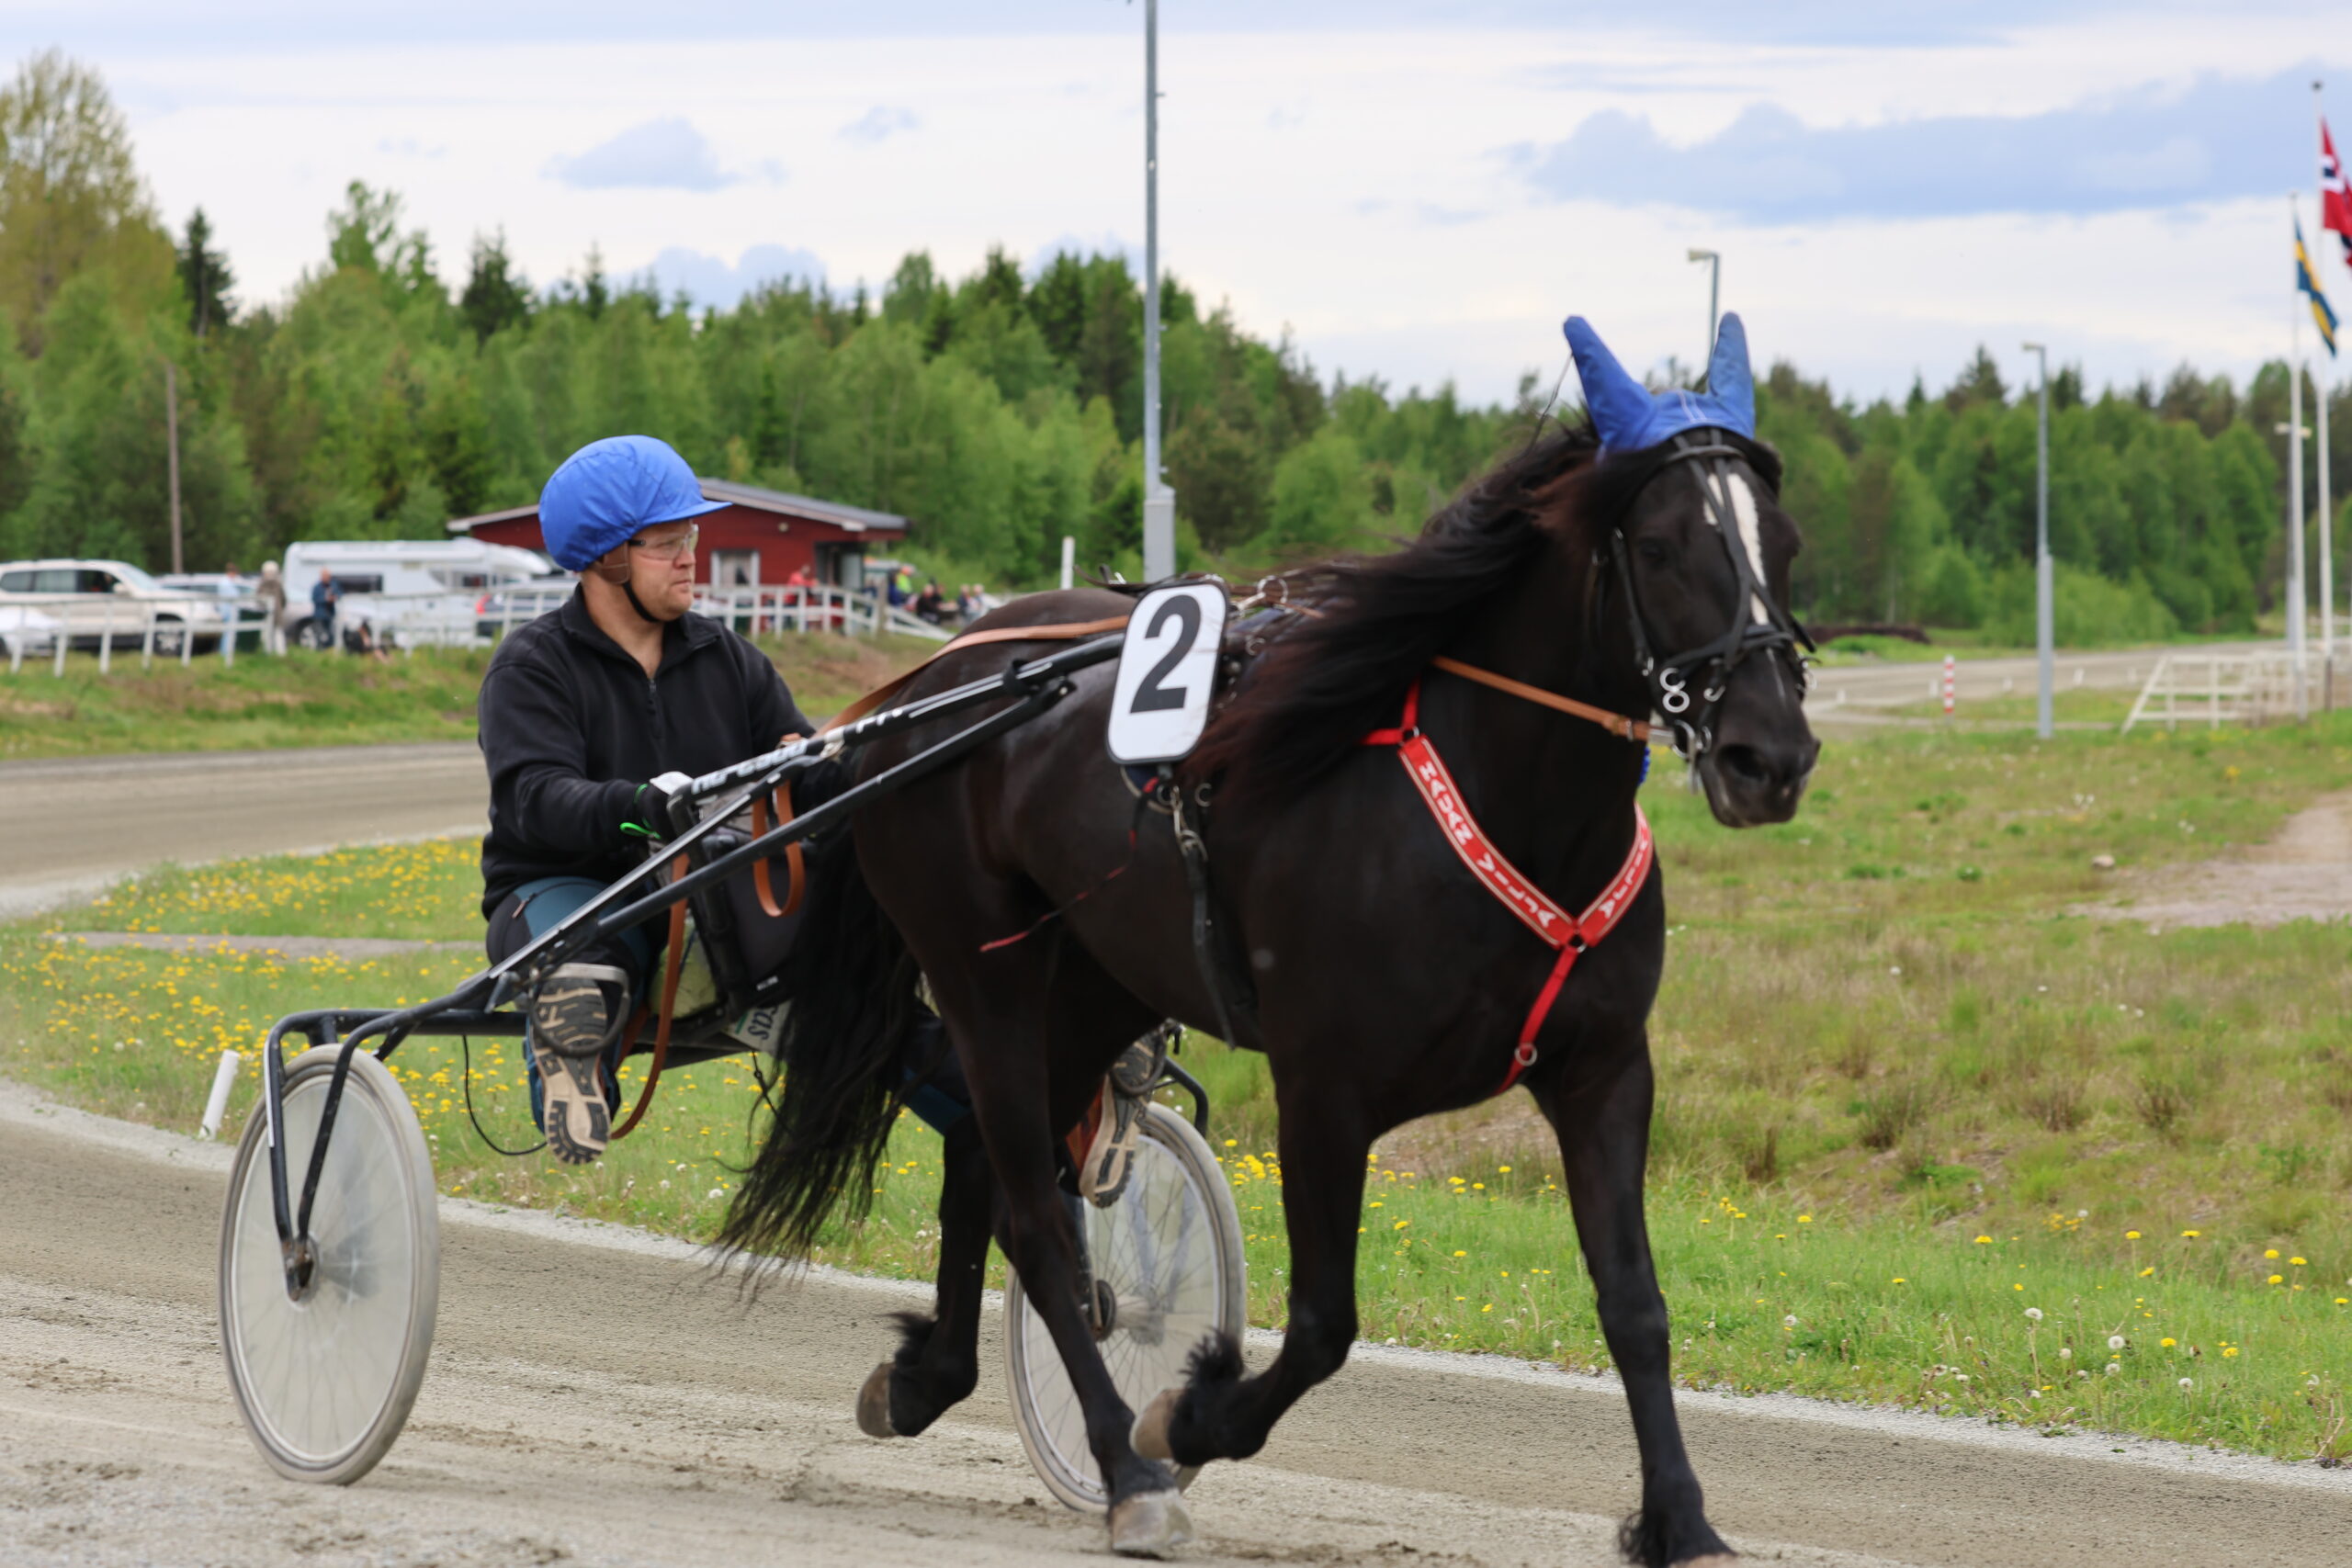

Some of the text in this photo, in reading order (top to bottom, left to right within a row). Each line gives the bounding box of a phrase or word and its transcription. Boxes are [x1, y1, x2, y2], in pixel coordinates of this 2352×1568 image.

[1129, 594, 1202, 714] 2
[1419, 761, 1556, 929] HAUAN VILJA
